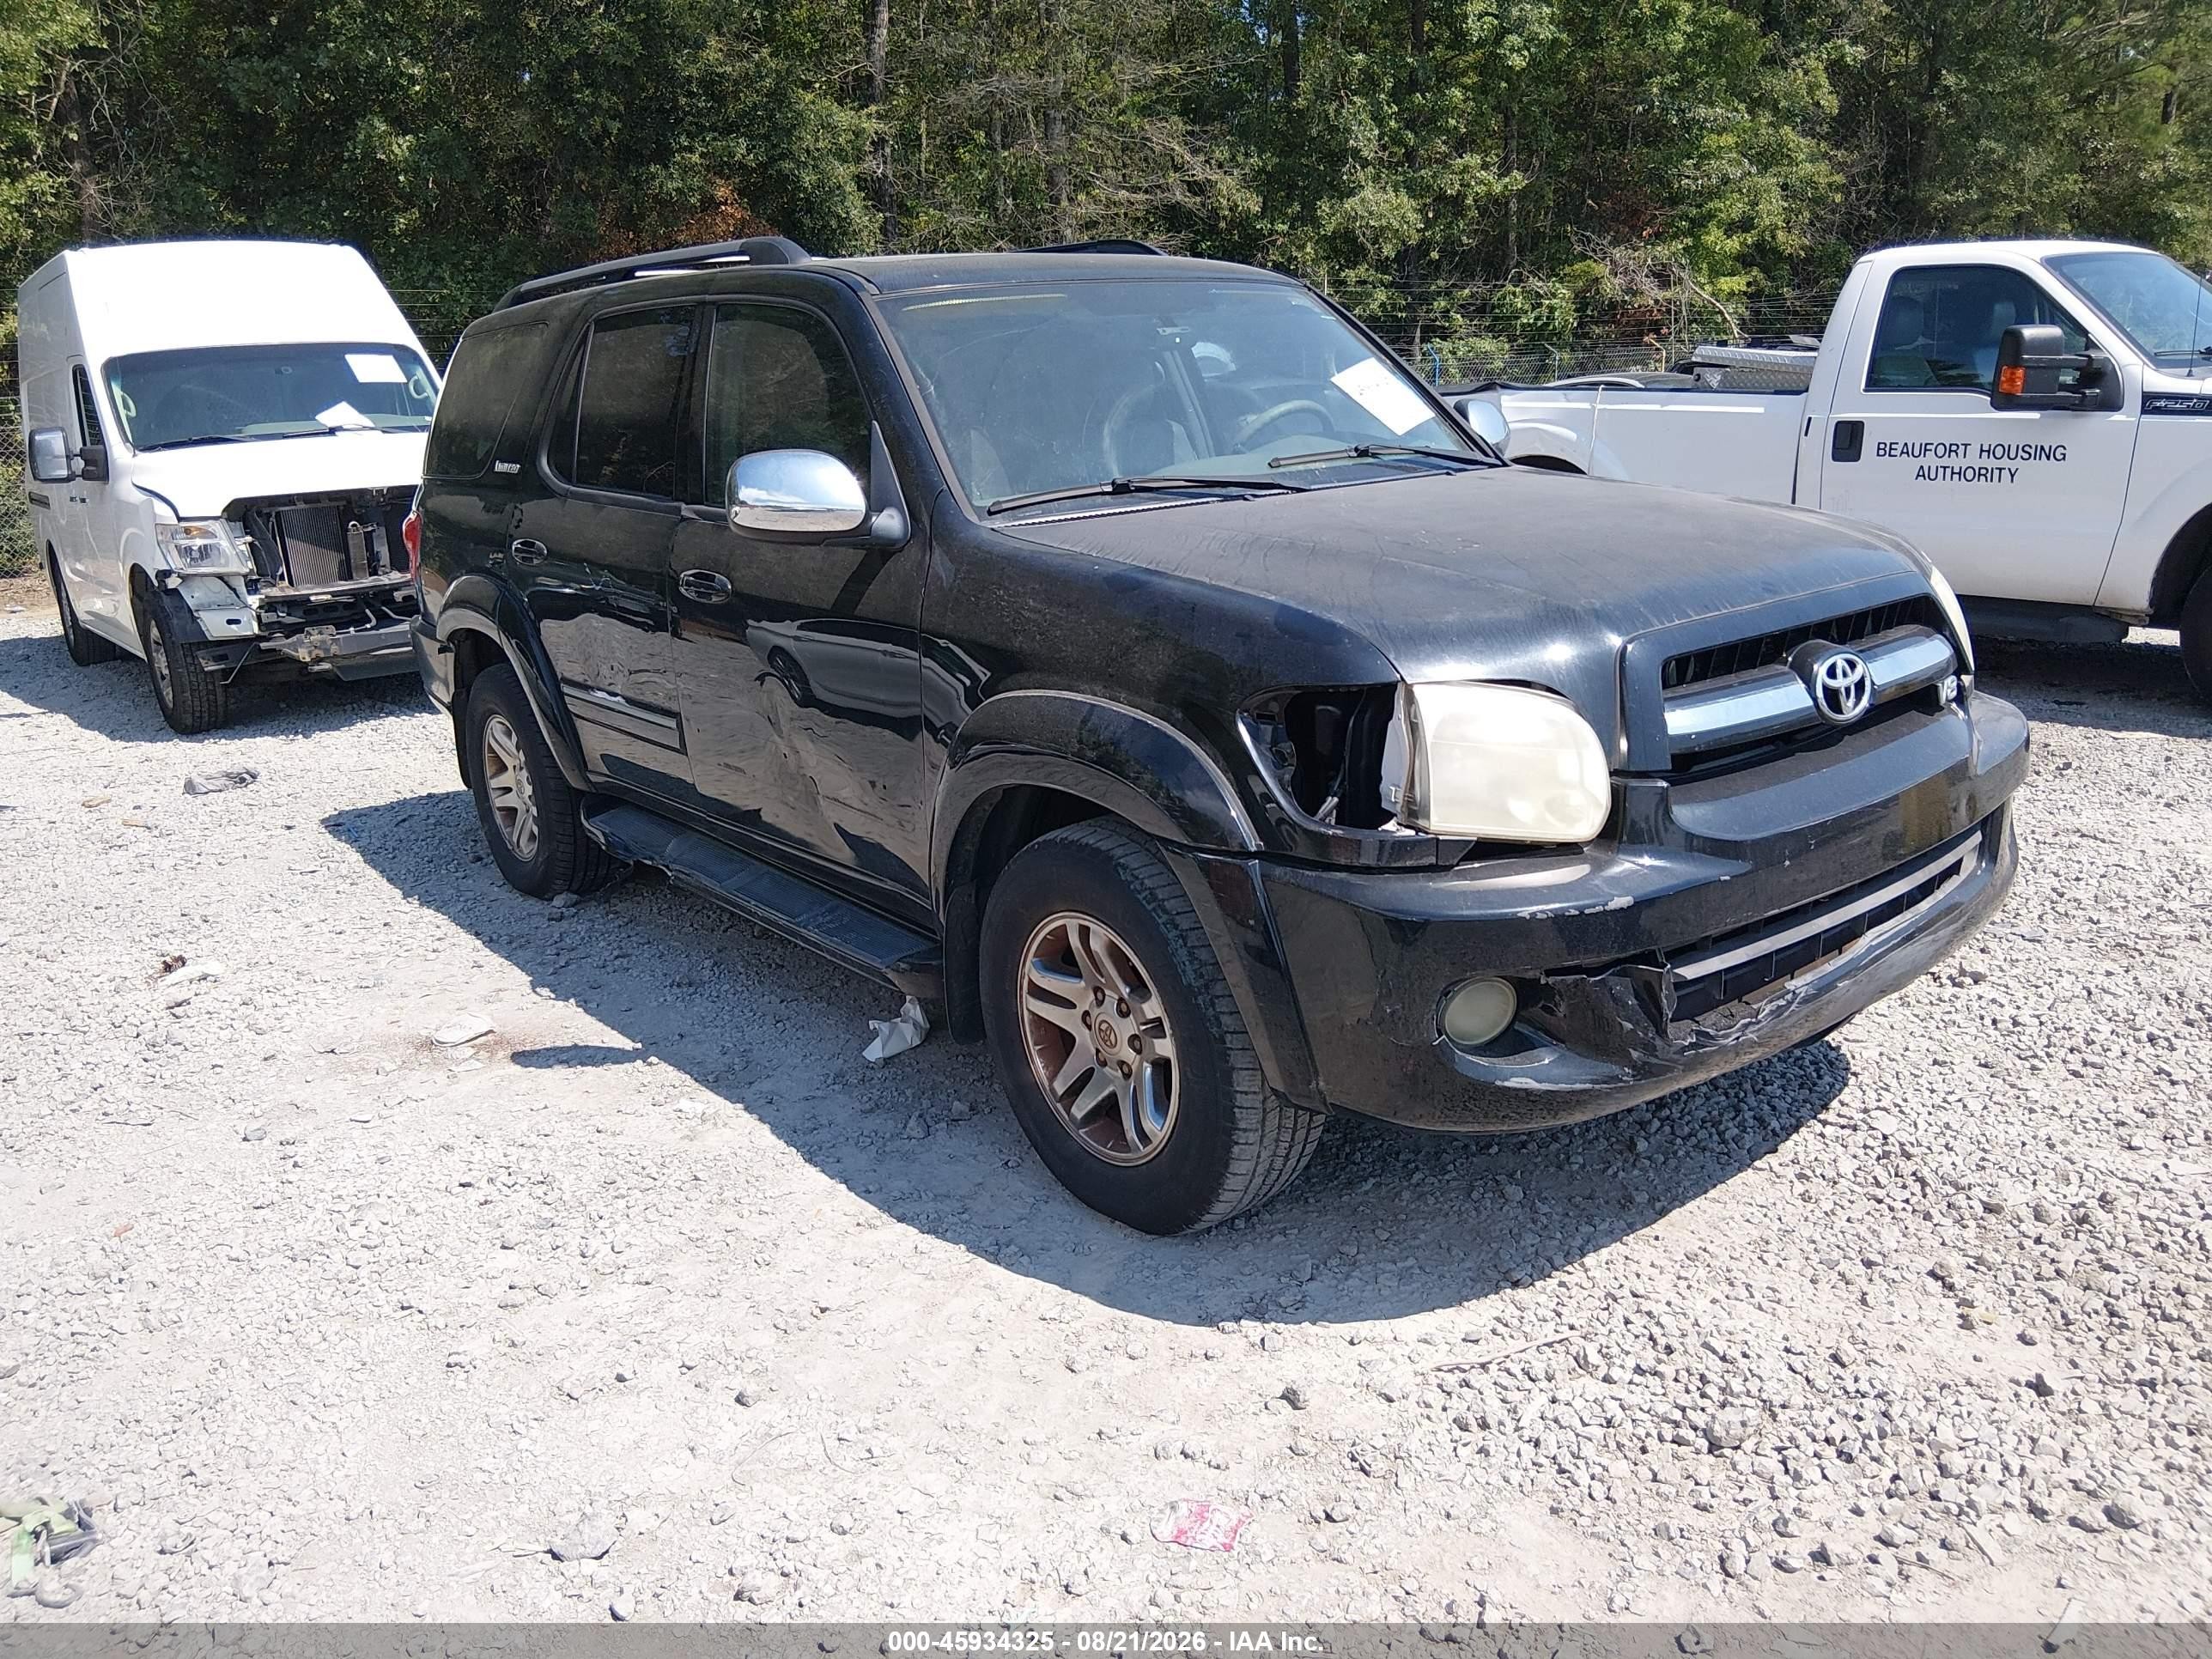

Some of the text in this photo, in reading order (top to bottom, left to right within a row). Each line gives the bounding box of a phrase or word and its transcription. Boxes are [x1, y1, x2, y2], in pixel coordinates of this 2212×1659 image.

[2144, 398, 2210, 410] F-250
[1875, 441, 2068, 462] BEAUFORT HOUSING
[1915, 465, 2020, 483] AUTHORITY
